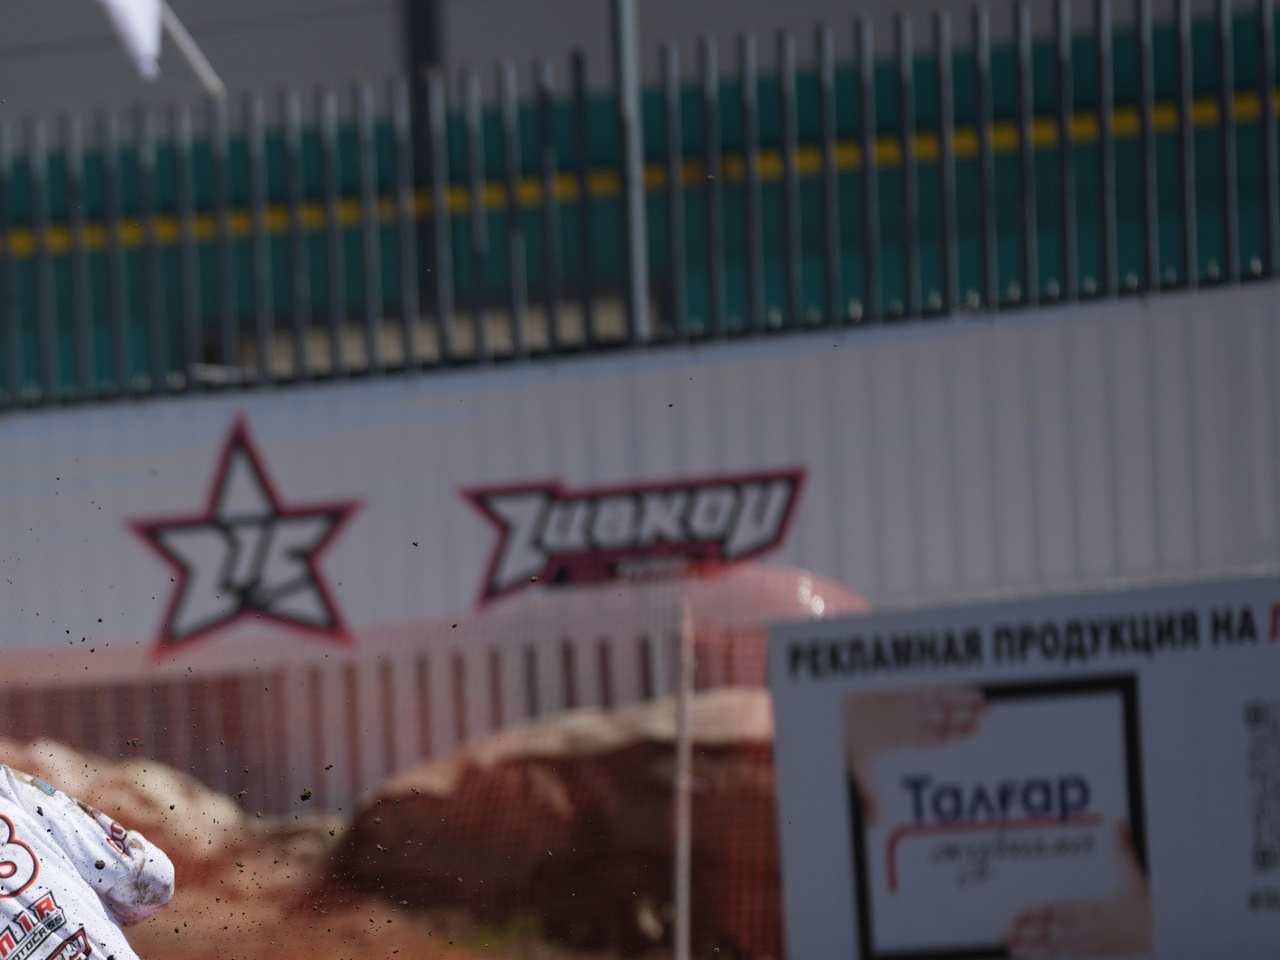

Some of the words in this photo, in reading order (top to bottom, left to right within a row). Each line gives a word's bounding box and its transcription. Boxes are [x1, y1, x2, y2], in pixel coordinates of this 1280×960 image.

[788, 627, 983, 680] РЕКЛАМНАЯ
[994, 609, 1200, 662] ПРОДУКЦИЯ
[1212, 606, 1259, 646] НА
